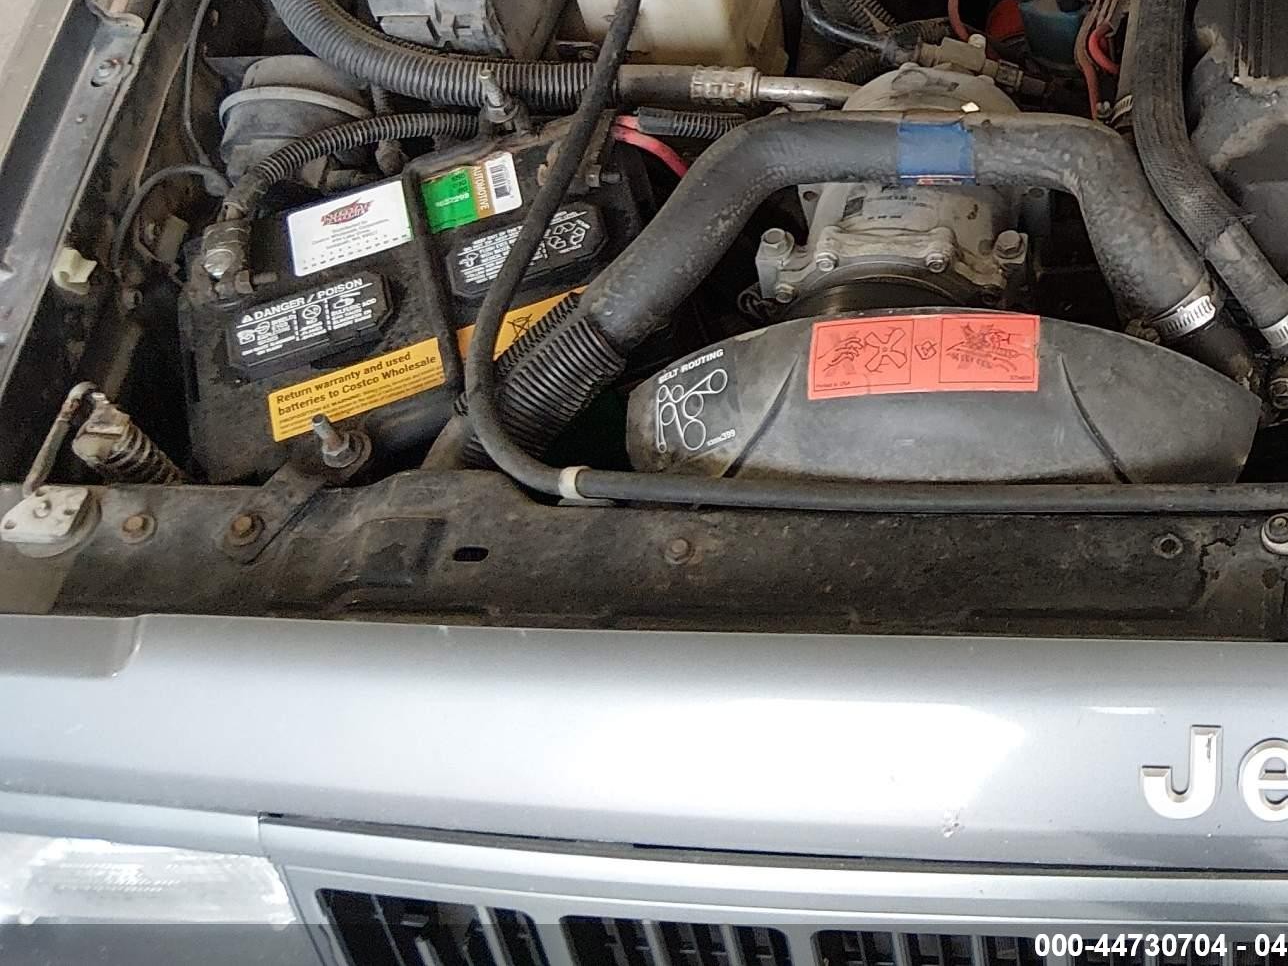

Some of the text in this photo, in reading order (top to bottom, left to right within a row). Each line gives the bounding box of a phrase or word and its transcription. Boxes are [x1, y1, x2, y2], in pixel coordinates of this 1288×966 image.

[472, 165, 490, 211] AUTOMOTIVE
[253, 297, 306, 320] DANGER
[316, 278, 364, 299] POISON
[276, 386, 313, 404] Return
[314, 370, 362, 392] warranty
[362, 361, 384, 375] and
[385, 352, 412, 367] used
[278, 394, 327, 416] batteries
[328, 389, 340, 398] to
[341, 376, 380, 394] Costco
[381, 355, 437, 379] Wholesale
[658, 349, 723, 384] BELT ROUTING
